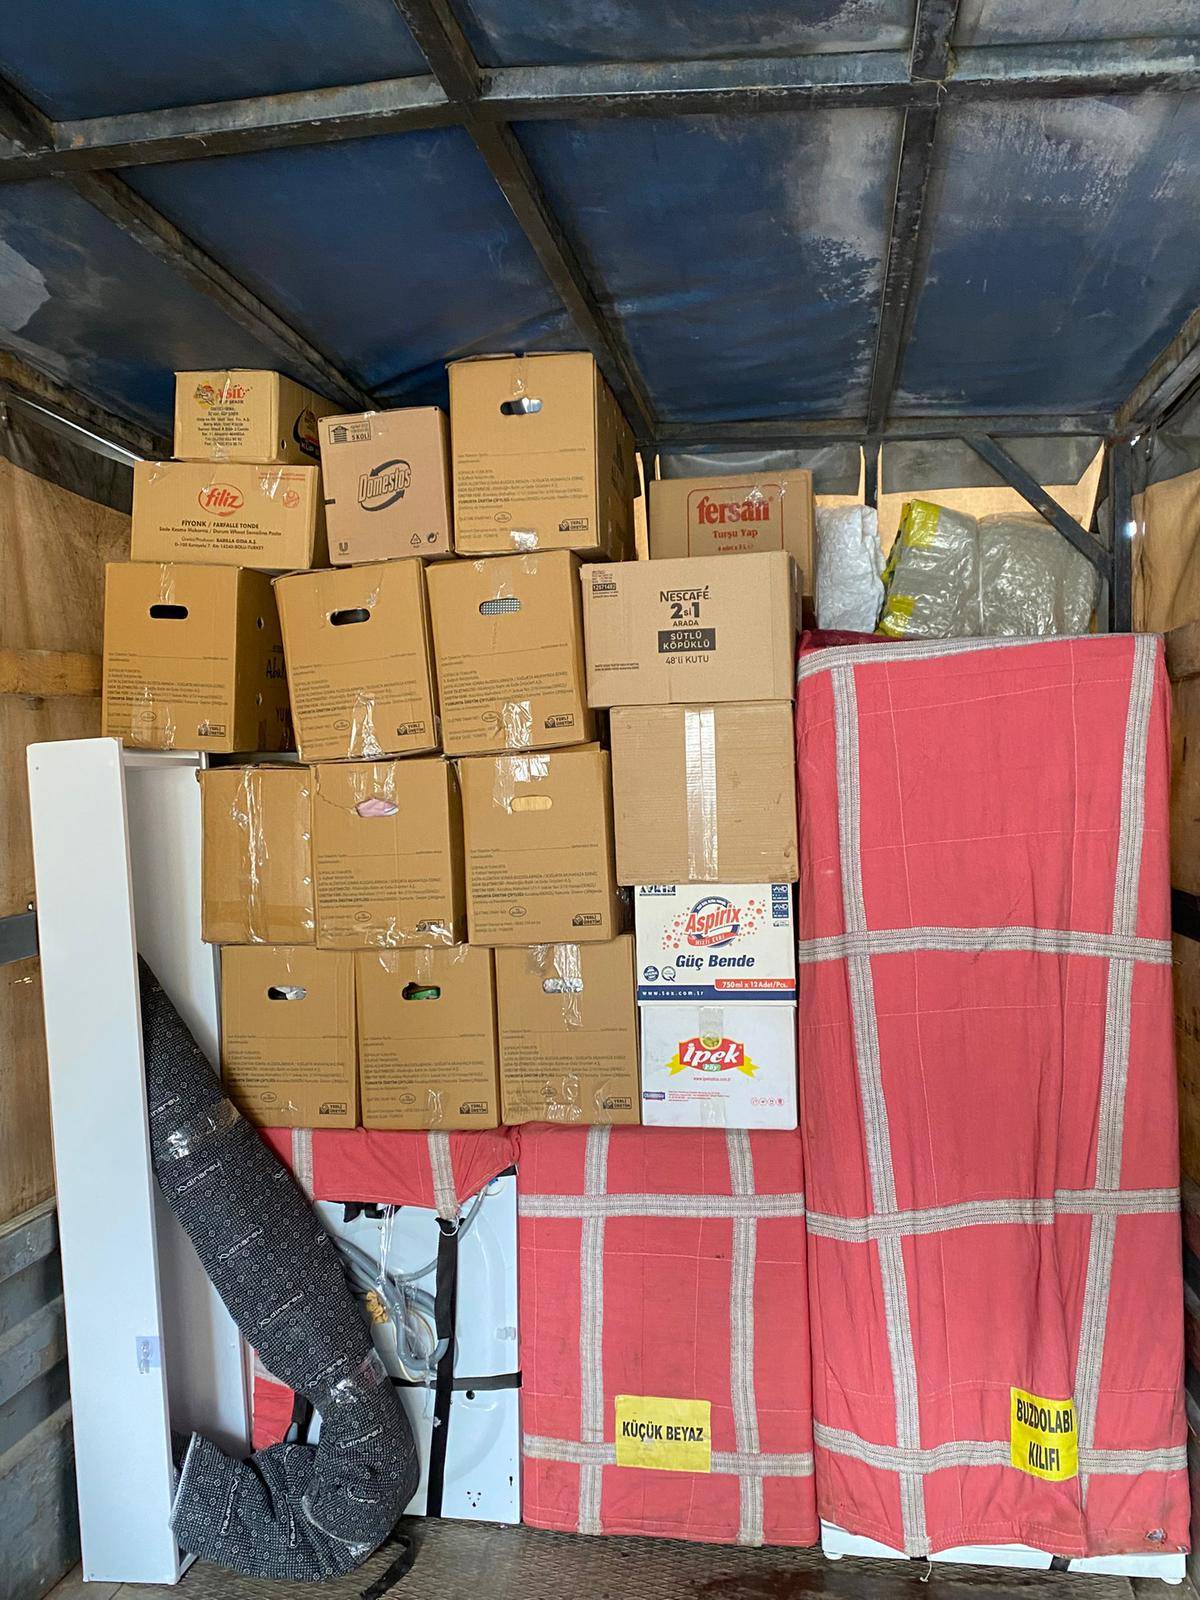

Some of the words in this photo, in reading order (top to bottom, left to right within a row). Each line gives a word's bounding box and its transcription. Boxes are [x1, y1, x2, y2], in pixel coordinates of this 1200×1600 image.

[358, 468, 412, 503] Domestos
[205, 487, 242, 509] filiz
[696, 495, 770, 525] fersan
[213, 521, 239, 529] FARFALLE
[741, 529, 758, 538] Yap
[660, 585, 709, 602] NESCAFÉ
[663, 639, 710, 650] KÖPÜKLÜ
[670, 630, 702, 640] SÜTLÜ
[685, 655, 709, 664] KUTU
[685, 902, 741, 935] Aspirix
[675, 955, 704, 970] Güç
[708, 954, 755, 967] Bende
[151, 1093, 181, 1118] inarsu
[186, 1161, 221, 1187] dinarsu
[229, 1228, 264, 1254] dinarsu
[270, 1292, 304, 1319] dinarsu
[1016, 1398, 1073, 1433] BUZDOLABI
[622, 1419, 663, 1441] KÜÇÜK
[666, 1426, 704, 1441] BEYAZ
[1028, 1441, 1060, 1472] KILIFI
